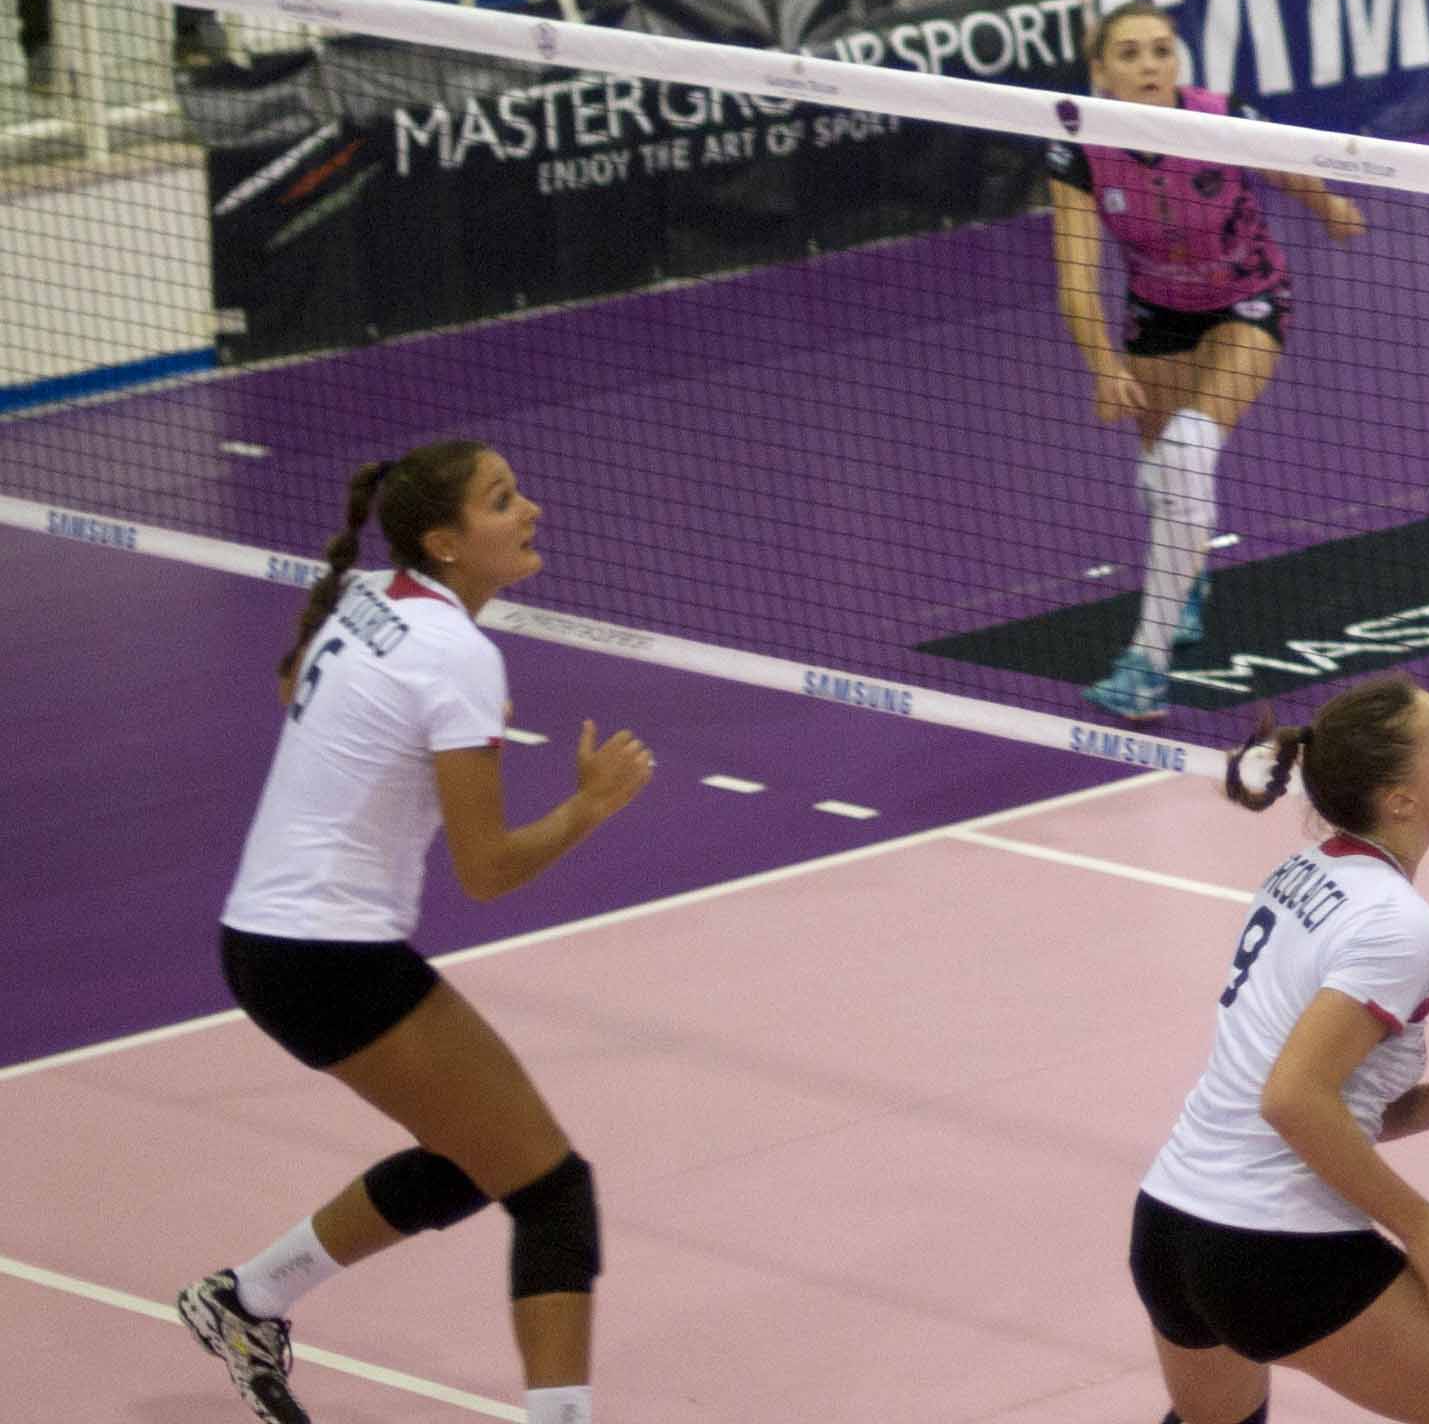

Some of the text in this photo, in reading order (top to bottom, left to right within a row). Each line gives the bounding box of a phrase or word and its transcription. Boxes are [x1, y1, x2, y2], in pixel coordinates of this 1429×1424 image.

[393, 75, 654, 178] MASTER
[537, 149, 633, 196] ENJOY
[704, 128, 754, 165] ART
[802, 669, 913, 715] SAMSUNG
[1069, 725, 1188, 773] SAMSUNG
[1218, 905, 1277, 1009] 9
